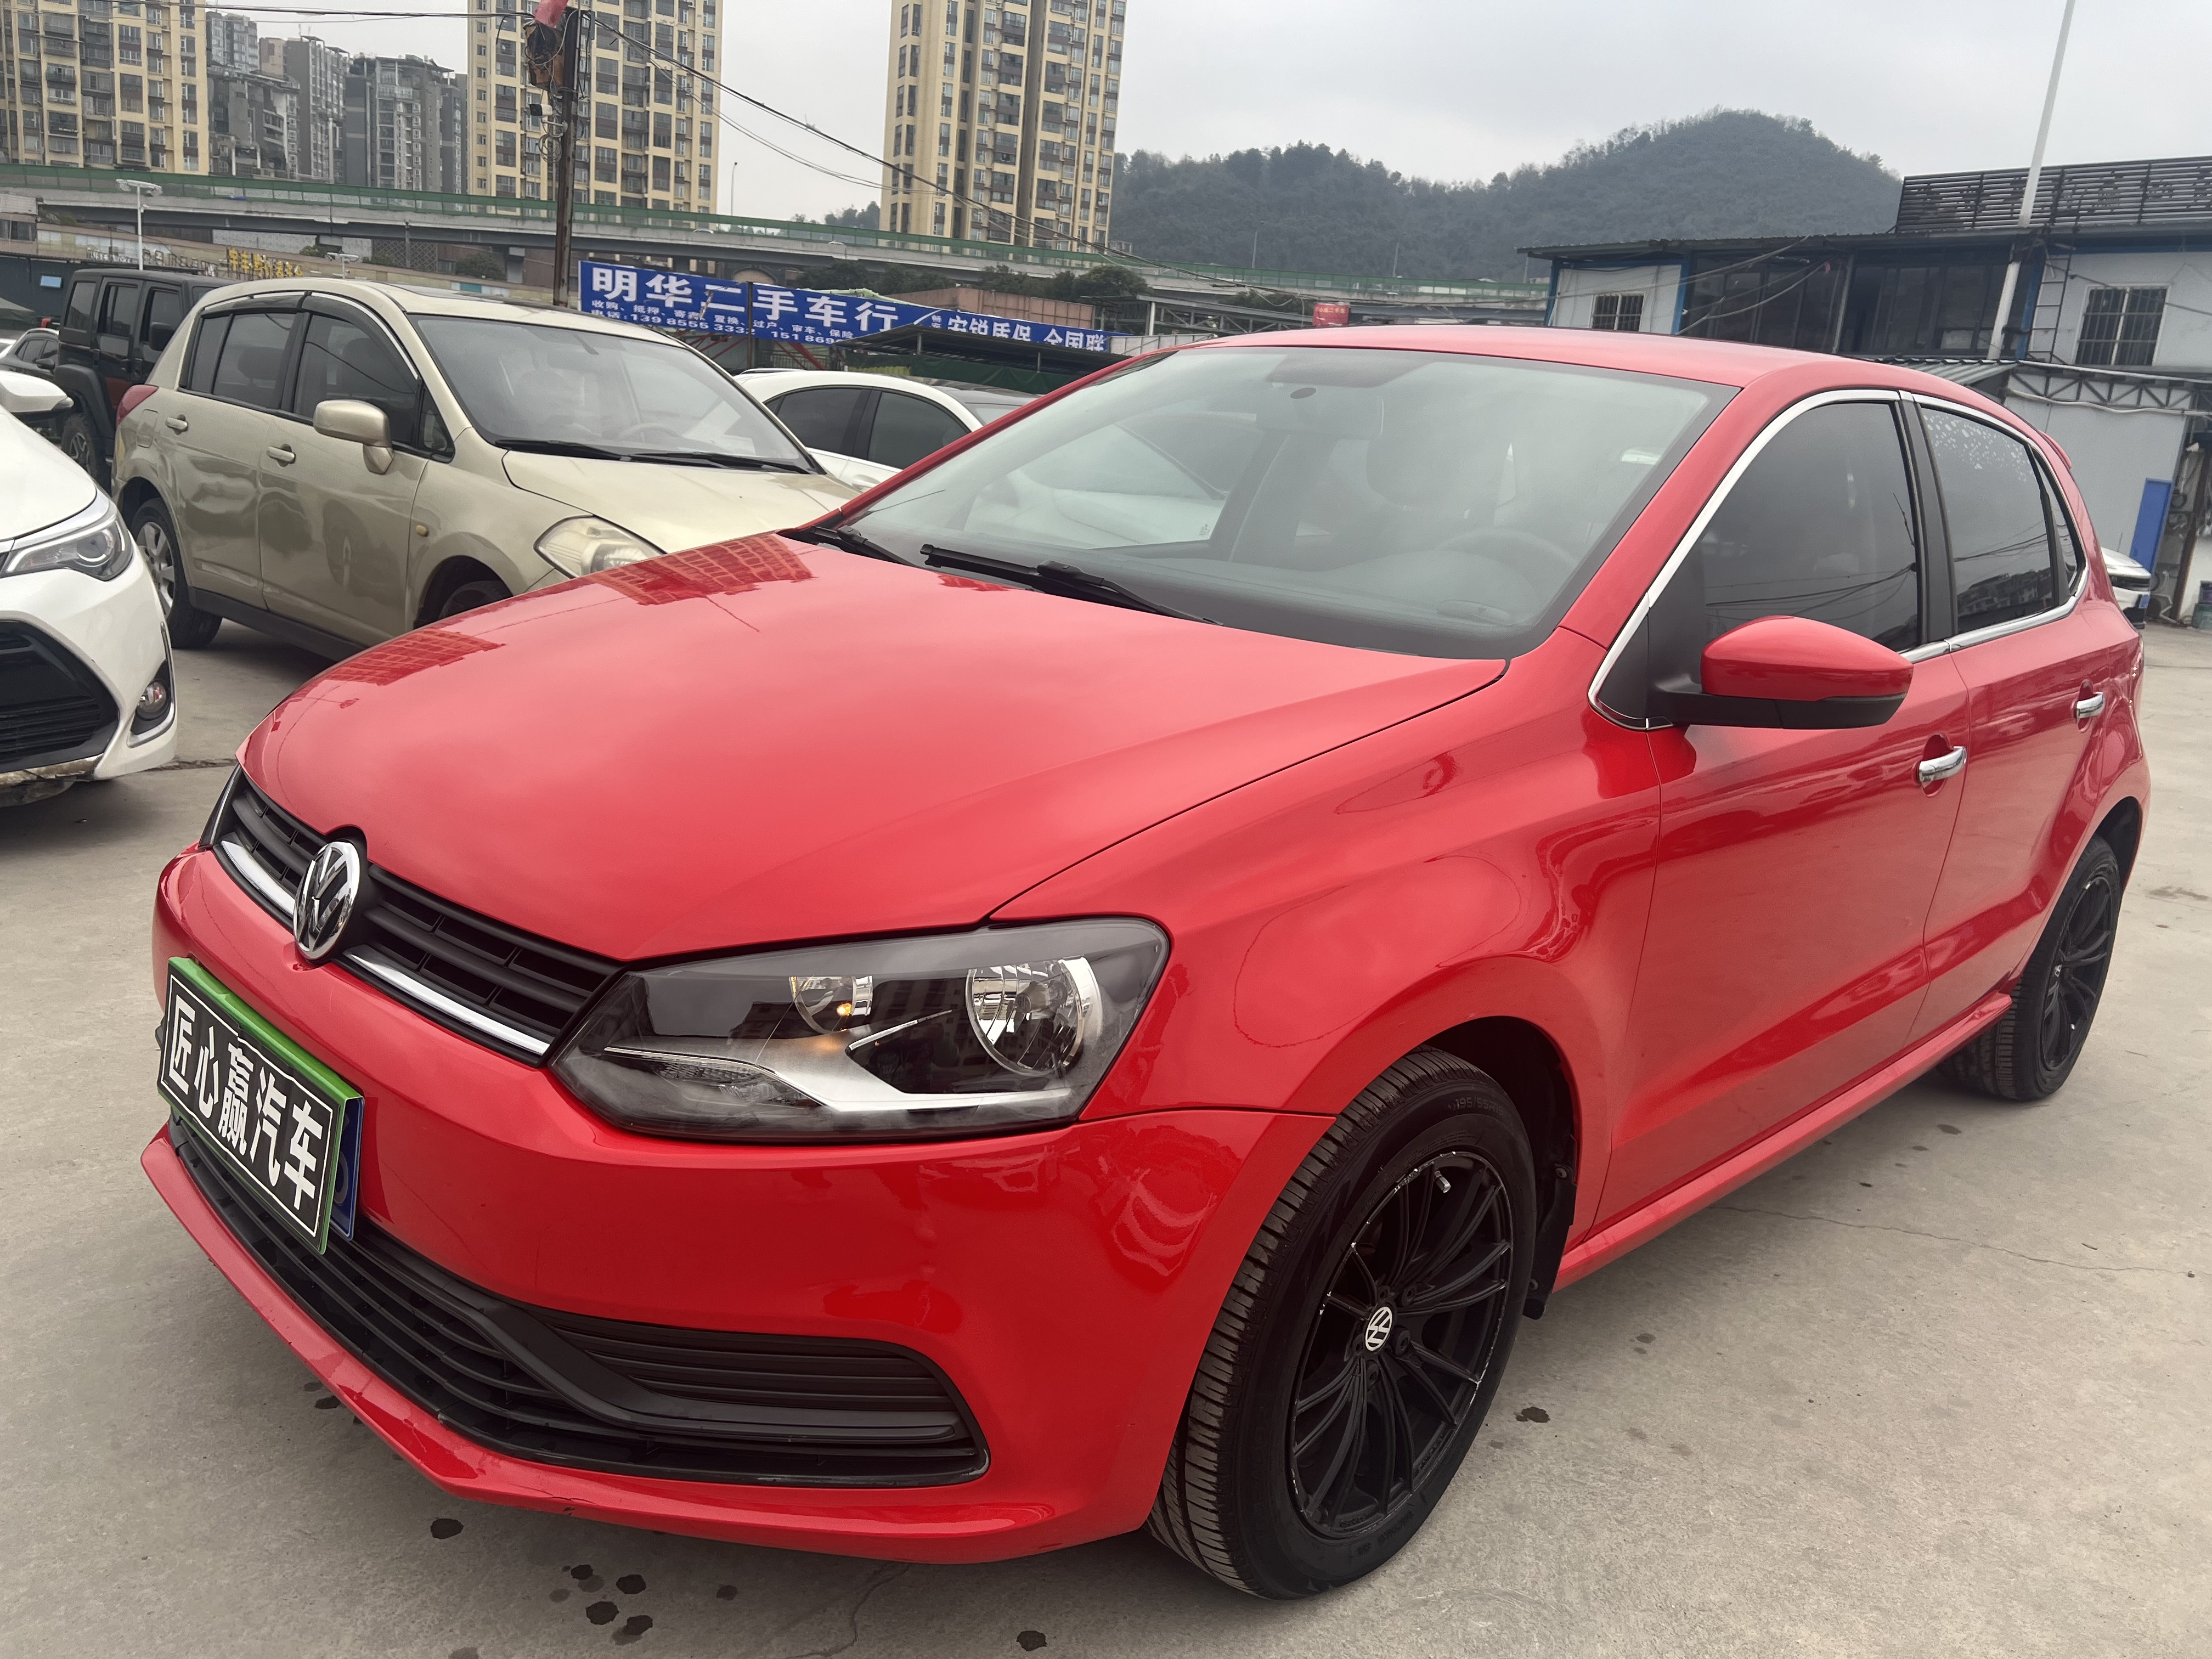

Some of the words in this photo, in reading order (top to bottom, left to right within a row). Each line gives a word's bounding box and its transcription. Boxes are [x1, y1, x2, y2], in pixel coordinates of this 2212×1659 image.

[592, 267, 899, 332] 明华二手车行
[666, 318, 709, 329] 8555
[771, 331, 799, 340] 151
[805, 335, 844, 345] 869
[168, 994, 323, 1210] 匠心赢汽车
